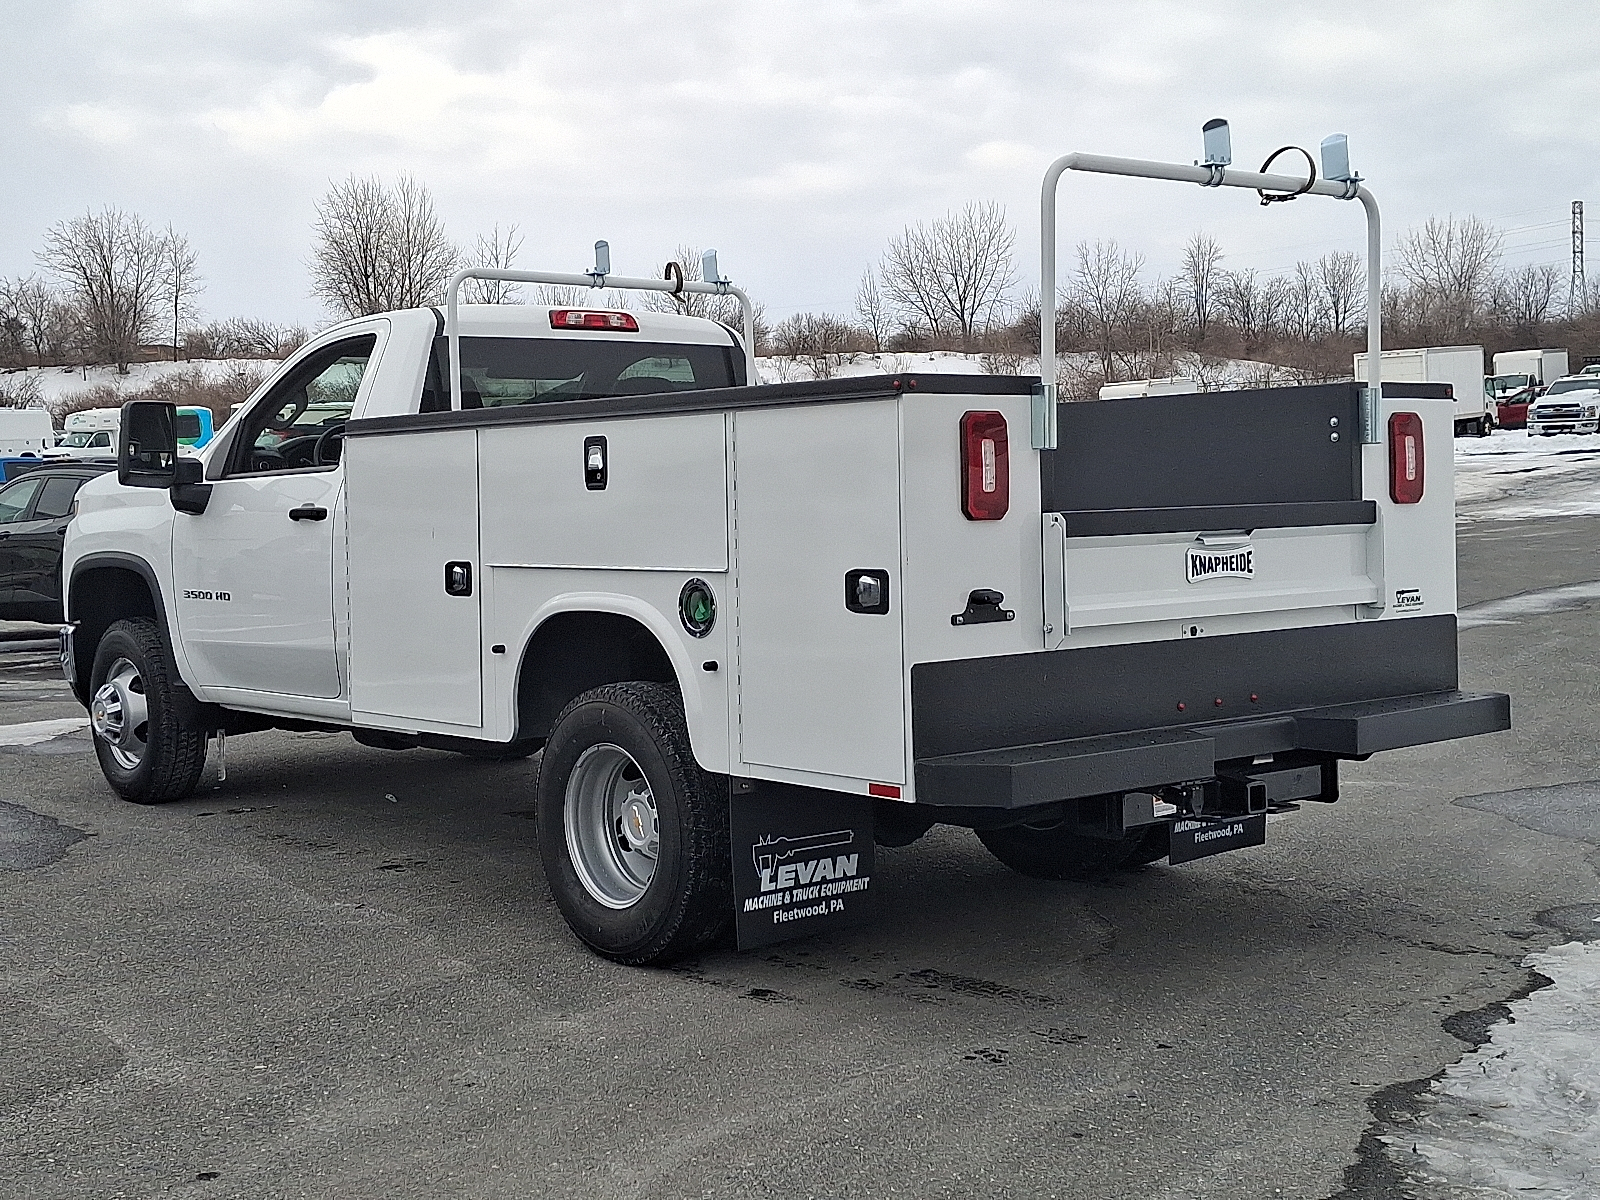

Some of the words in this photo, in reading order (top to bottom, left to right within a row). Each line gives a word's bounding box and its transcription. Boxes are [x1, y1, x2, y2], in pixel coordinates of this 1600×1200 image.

[1190, 550, 1253, 578] KNAPHEIDE
[183, 590, 213, 600] 3500
[215, 591, 231, 601] HD
[1397, 595, 1421, 604] LEVAN
[1194, 825, 1232, 844] Fleetwood,
[1233, 823, 1244, 834] PA
[760, 853, 859, 892] LEVAN
[743, 892, 783, 913] MACHINE
[784, 890, 791, 904] &
[792, 885, 820, 901] TRUCK
[820, 876, 870, 897] EQUIPMENT
[773, 901, 829, 924] Fleetwood,
[830, 898, 844, 913] PA
